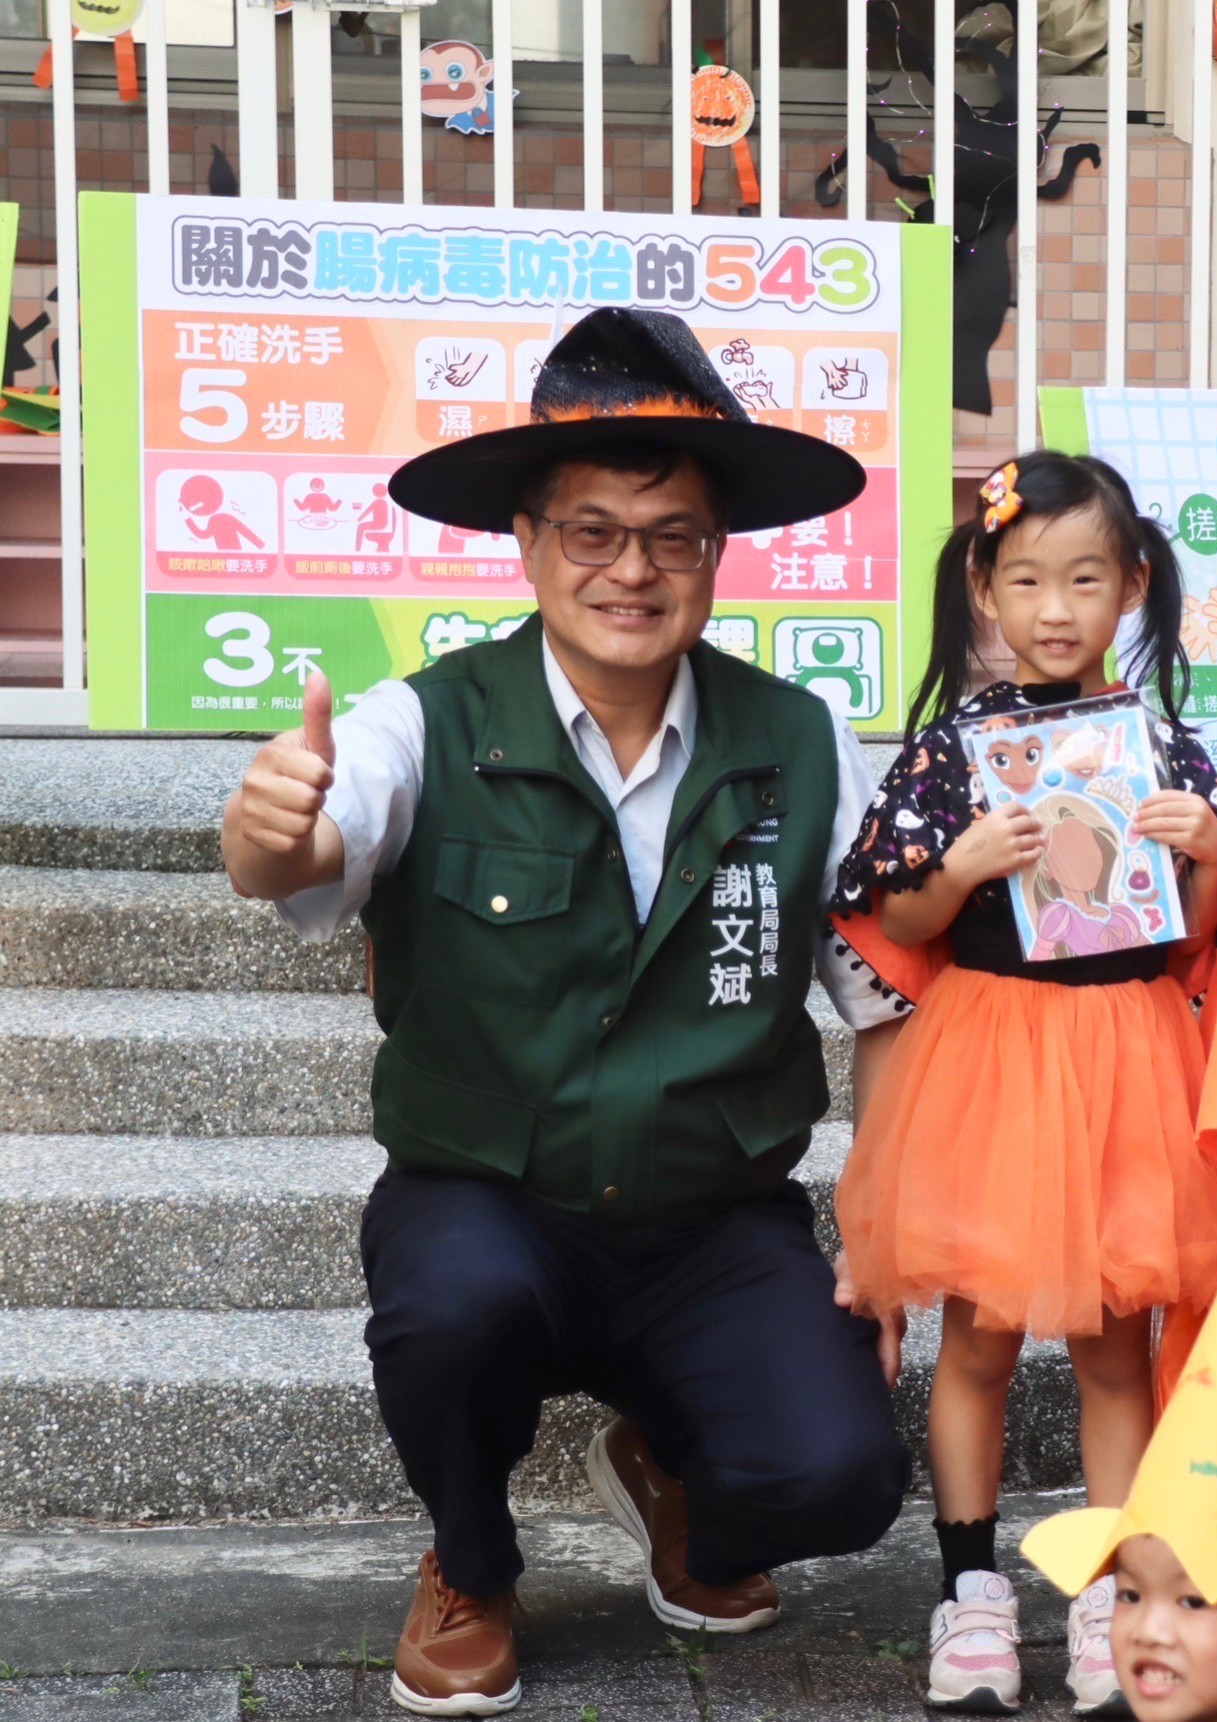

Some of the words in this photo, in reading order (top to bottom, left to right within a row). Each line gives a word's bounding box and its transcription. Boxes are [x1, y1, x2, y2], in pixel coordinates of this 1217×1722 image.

[179, 223, 876, 308] 關於腸病毒防治的543
[175, 321, 344, 365] 正確洗手
[438, 405, 474, 438] 濕
[824, 414, 856, 446] 擦
[1186, 506, 1217, 541] 搓
[770, 551, 873, 591] 注意！
[708, 863, 754, 1006] 謝文斌
[755, 862, 780, 978] 教育局局長
